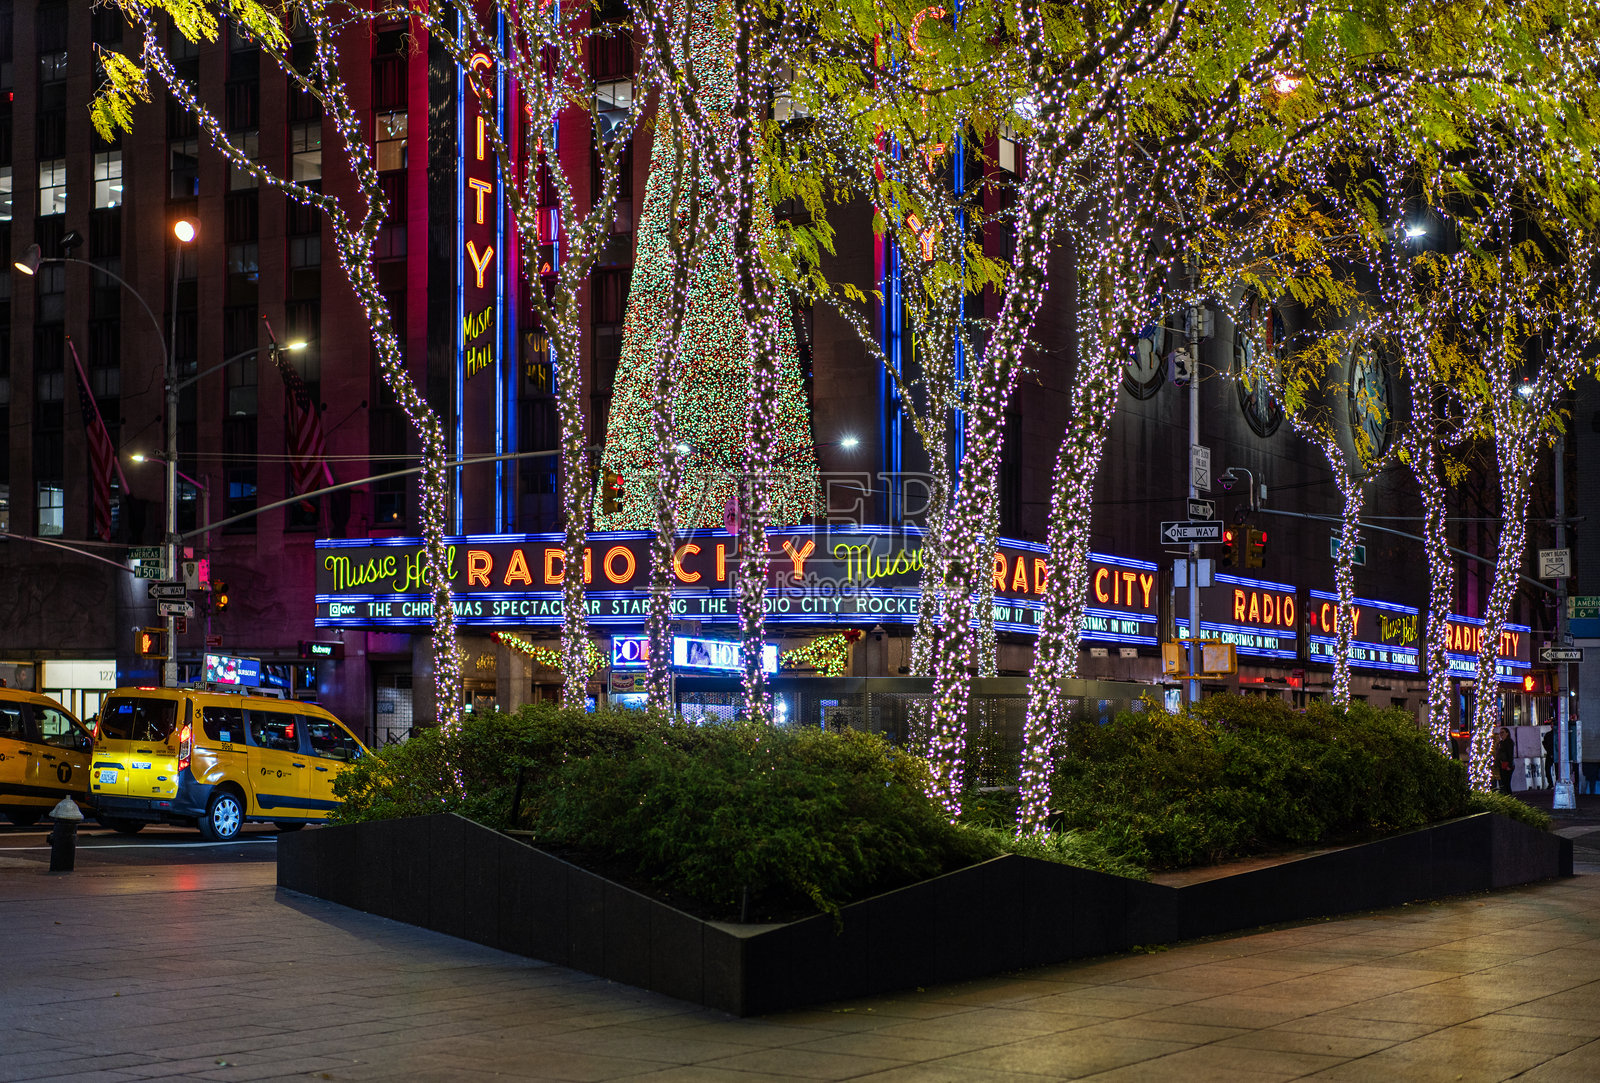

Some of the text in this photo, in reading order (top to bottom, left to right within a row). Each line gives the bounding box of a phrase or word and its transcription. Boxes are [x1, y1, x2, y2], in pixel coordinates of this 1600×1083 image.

[466, 53, 494, 288] CITY
[467, 343, 494, 379] HALL
[1170, 527, 1216, 537] ONE WAY
[130, 551, 159, 559] AMERICAS
[1554, 550, 1568, 558] BLOCK
[467, 539, 816, 588] RADIO CIY
[135, 569, 142, 577] W
[143, 568, 154, 578] 50
[992, 552, 1049, 594] RAD
[1095, 567, 1154, 608] CITY
[152, 587, 184, 595] ONE WAY
[368, 602, 392, 616] THE
[402, 601, 483, 617] CHRIMAS
[493, 600, 600, 615] SPECTACAR
[611, 599, 687, 614] STARNG
[700, 598, 728, 613] THE
[761, 597, 791, 613] DIO
[801, 597, 842, 613] CITY
[856, 597, 918, 613] ROCKE
[1234, 588, 1360, 636] RADIO CIY
[1579, 609, 1586, 618] 6
[993, 606, 1011, 621] NOV
[1014, 608, 1024, 623] 17
[1111, 620, 1119, 633] IN
[1121, 621, 1140, 635] NYC!
[1221, 632, 1255, 647] CHRISTMAS
[1256, 635, 1263, 648] IN
[1499, 632, 1519, 657] ITY
[311, 645, 332, 655] Subway
[1310, 642, 1320, 655] SEE
[1391, 652, 1416, 666] CHRISTMAS
[1546, 651, 1578, 659] ONE WAY
